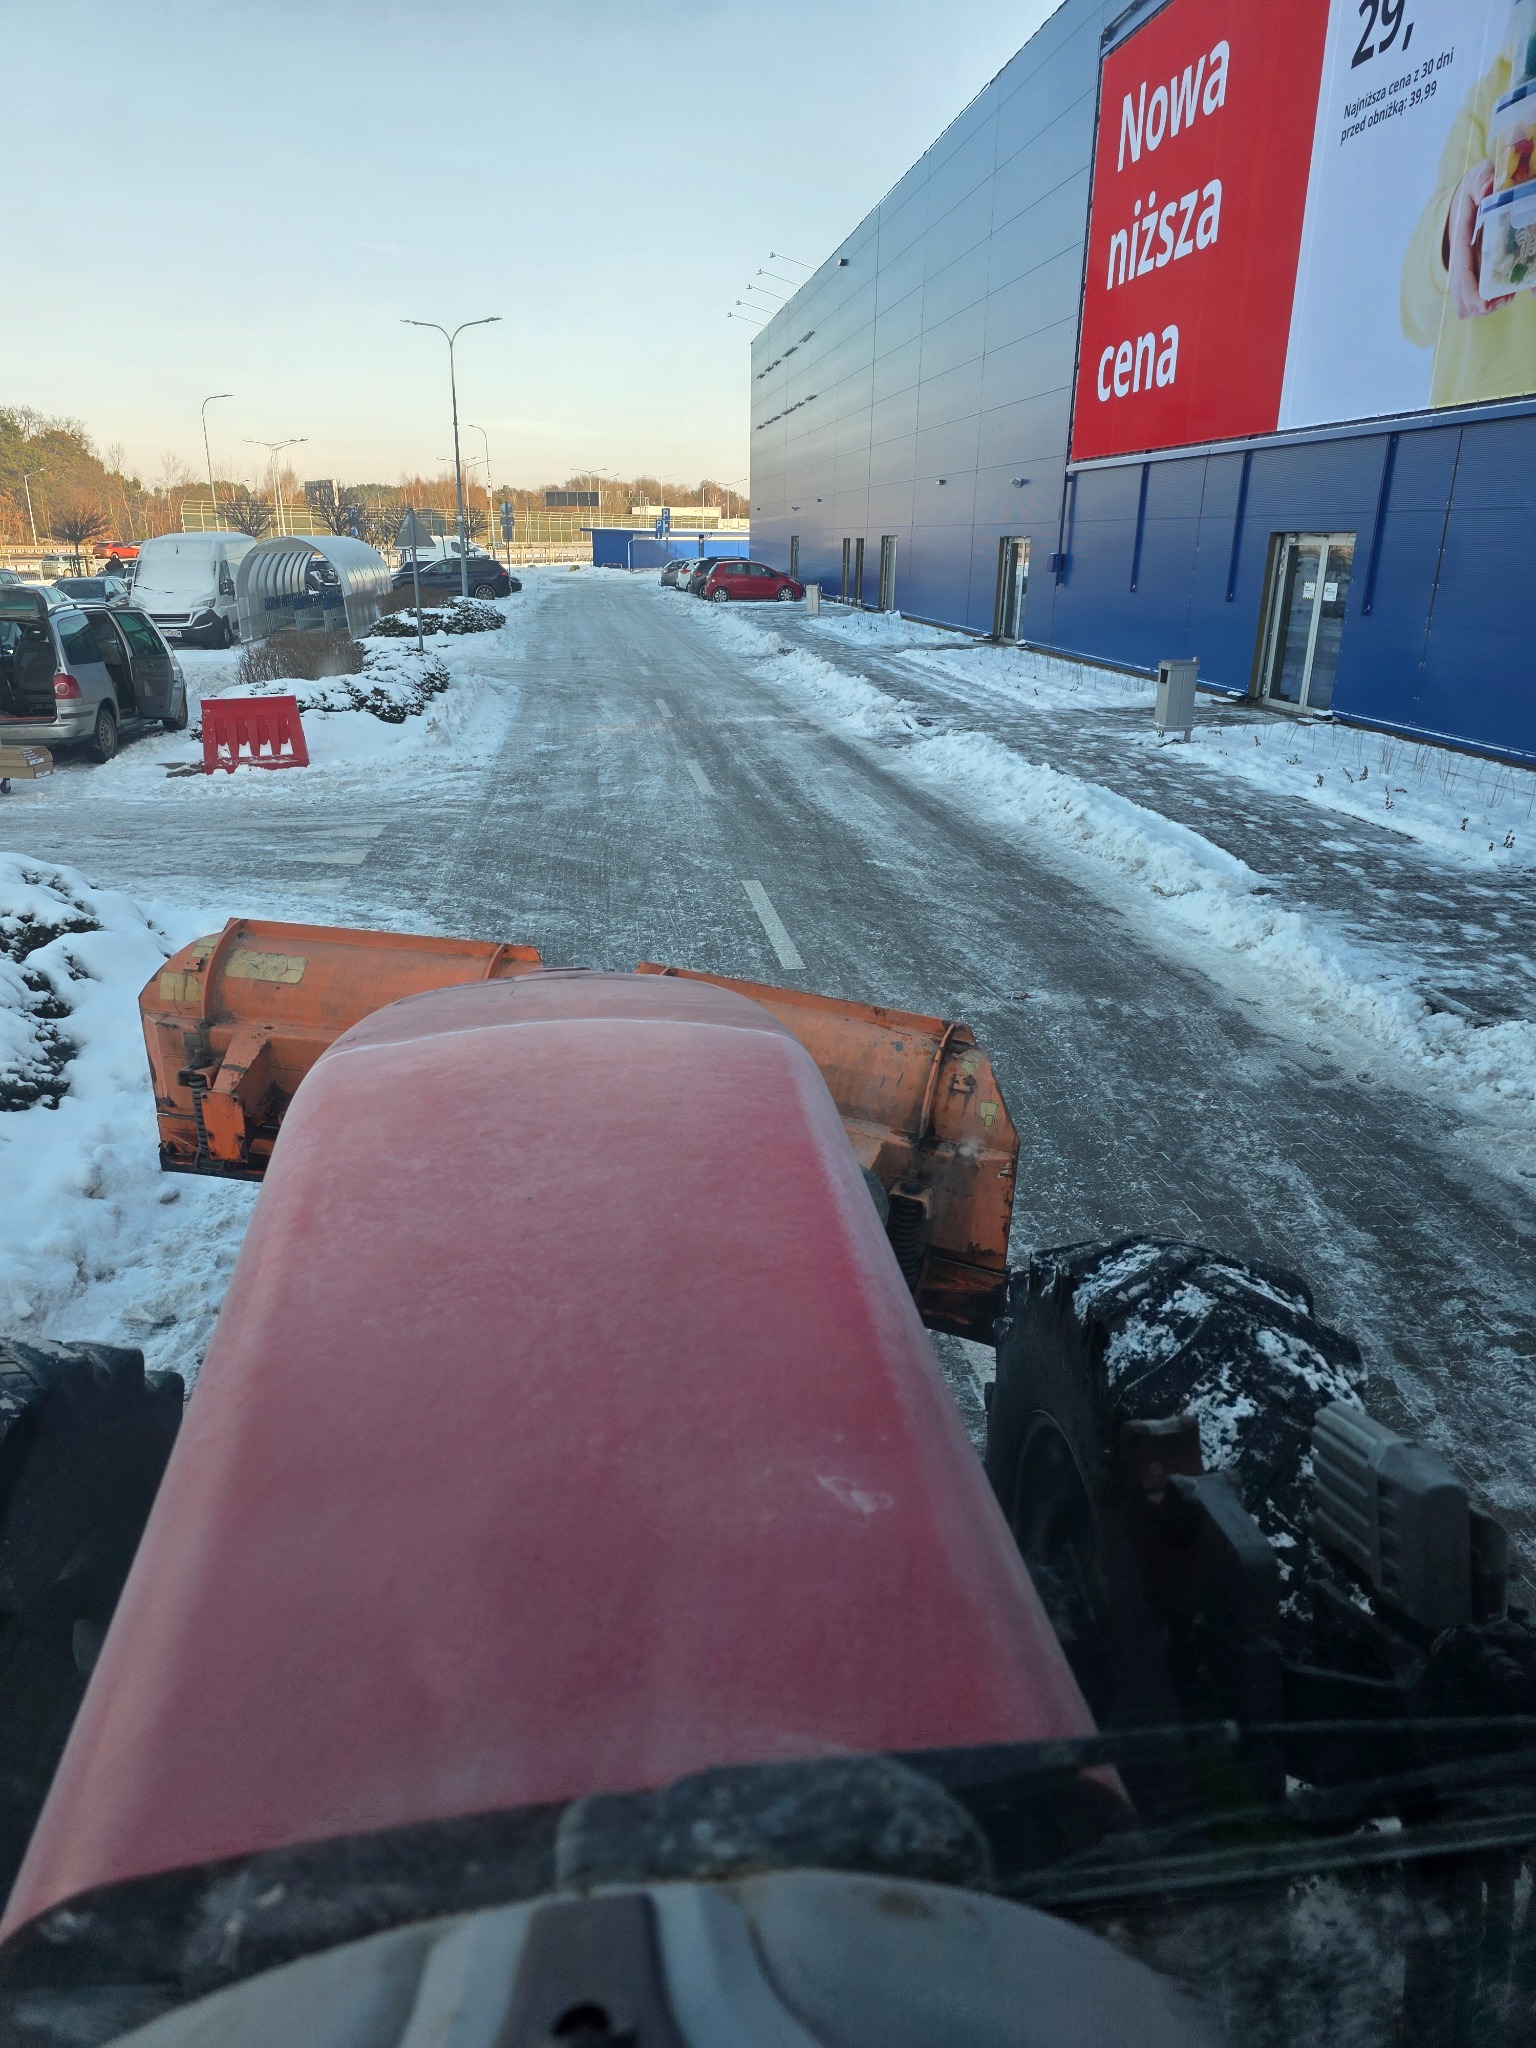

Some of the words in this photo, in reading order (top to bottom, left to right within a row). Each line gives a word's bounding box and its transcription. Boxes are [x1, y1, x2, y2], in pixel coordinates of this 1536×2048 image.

[1350, 0, 1415, 70] 29,
[1117, 40, 1230, 173] Nowa
[1340, 115, 1366, 147] przed
[1367, 97, 1408, 128] obniżką:
[1408, 80, 1437, 109] 39,99
[1343, 87, 1386, 120] Najniższa
[1388, 73, 1411, 96] cena
[1413, 69, 1420, 83] z
[1421, 58, 1434, 79] 30
[1436, 46, 1454, 71] dni
[1106, 178, 1222, 291] niższa
[1097, 324, 1179, 402] cena
[662, 509, 668, 520] P
